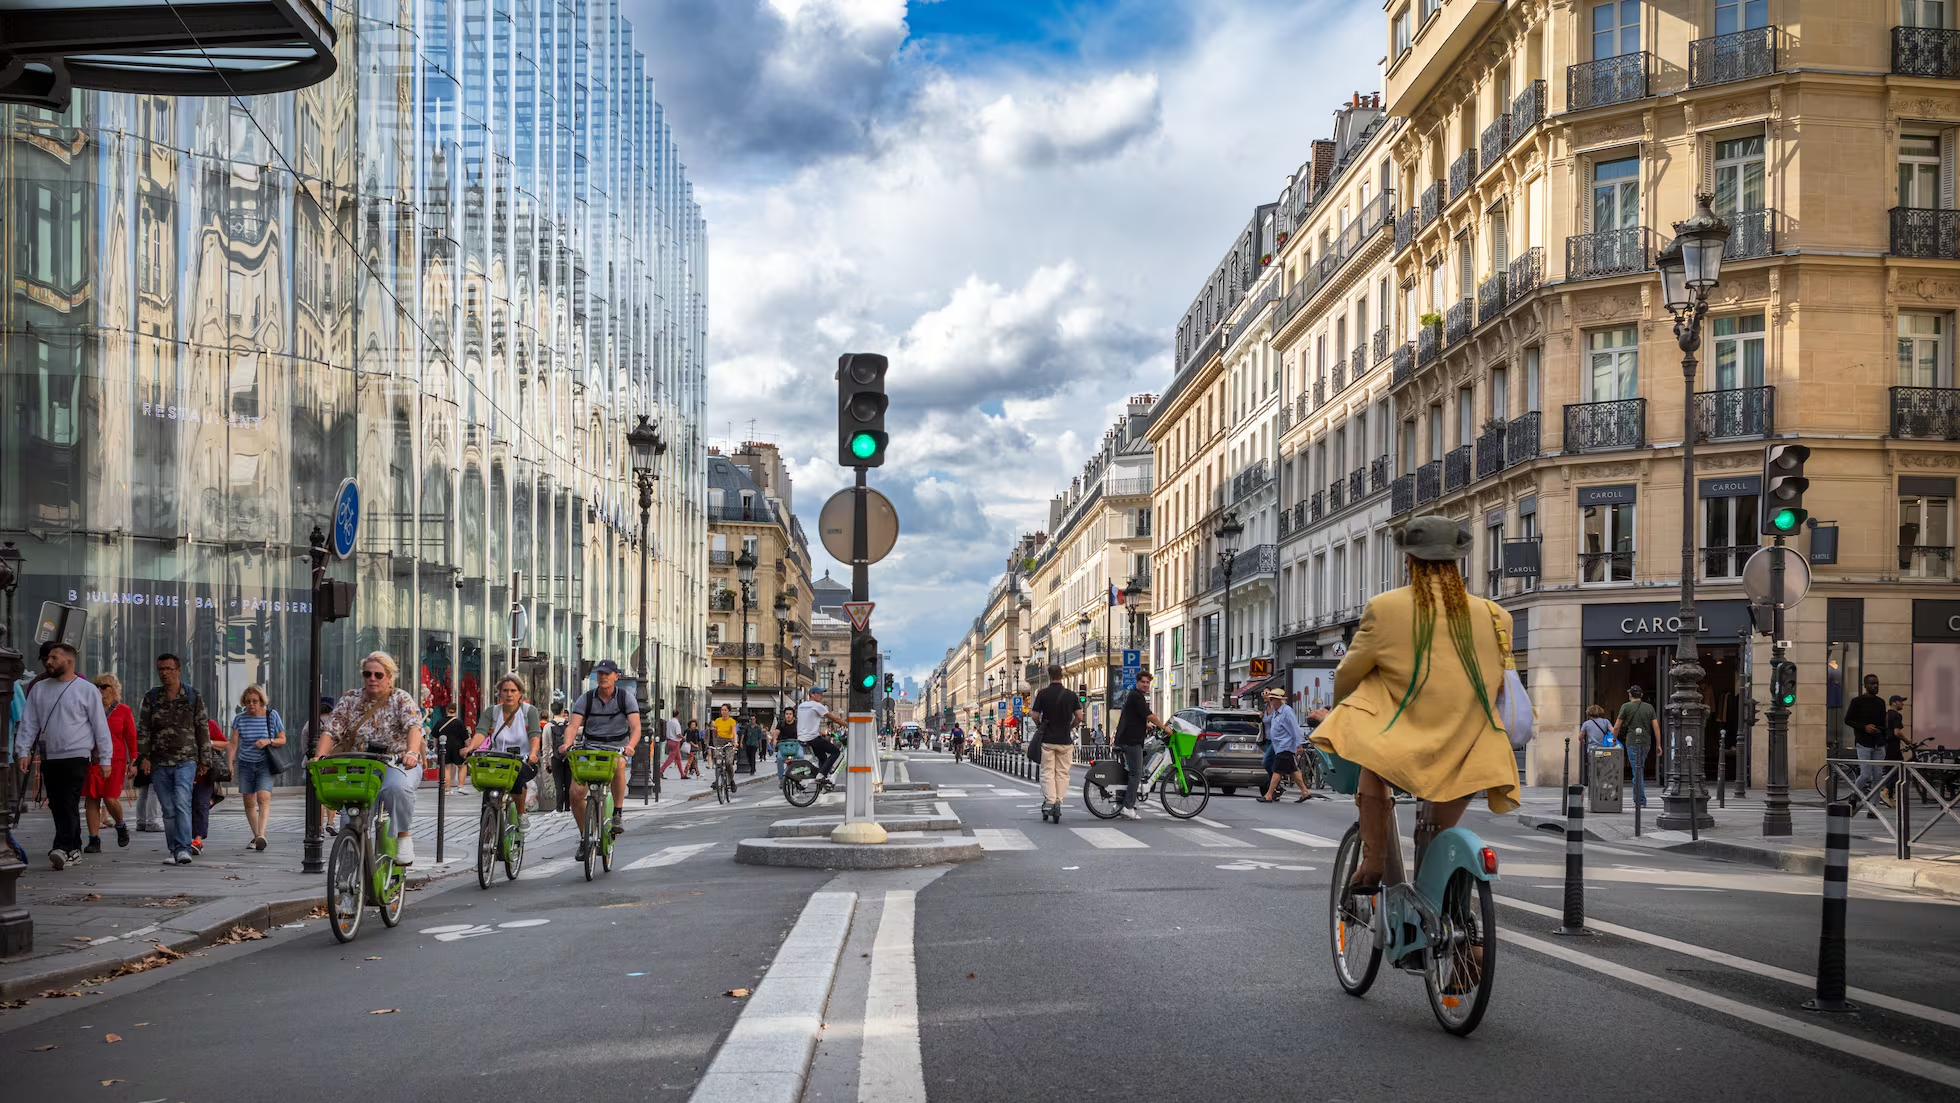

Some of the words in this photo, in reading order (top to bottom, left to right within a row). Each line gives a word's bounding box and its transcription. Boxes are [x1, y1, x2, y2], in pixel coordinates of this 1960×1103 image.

[143, 402, 261, 430] RESTAUANT
[1712, 482, 1747, 491] CAROLL
[1590, 491, 1623, 499] CAROLL
[1508, 566, 1537, 574] CAROLL
[1620, 616, 1709, 633] CAROL
[1127, 652, 1136, 665] P
[1254, 660, 1264, 672] N
